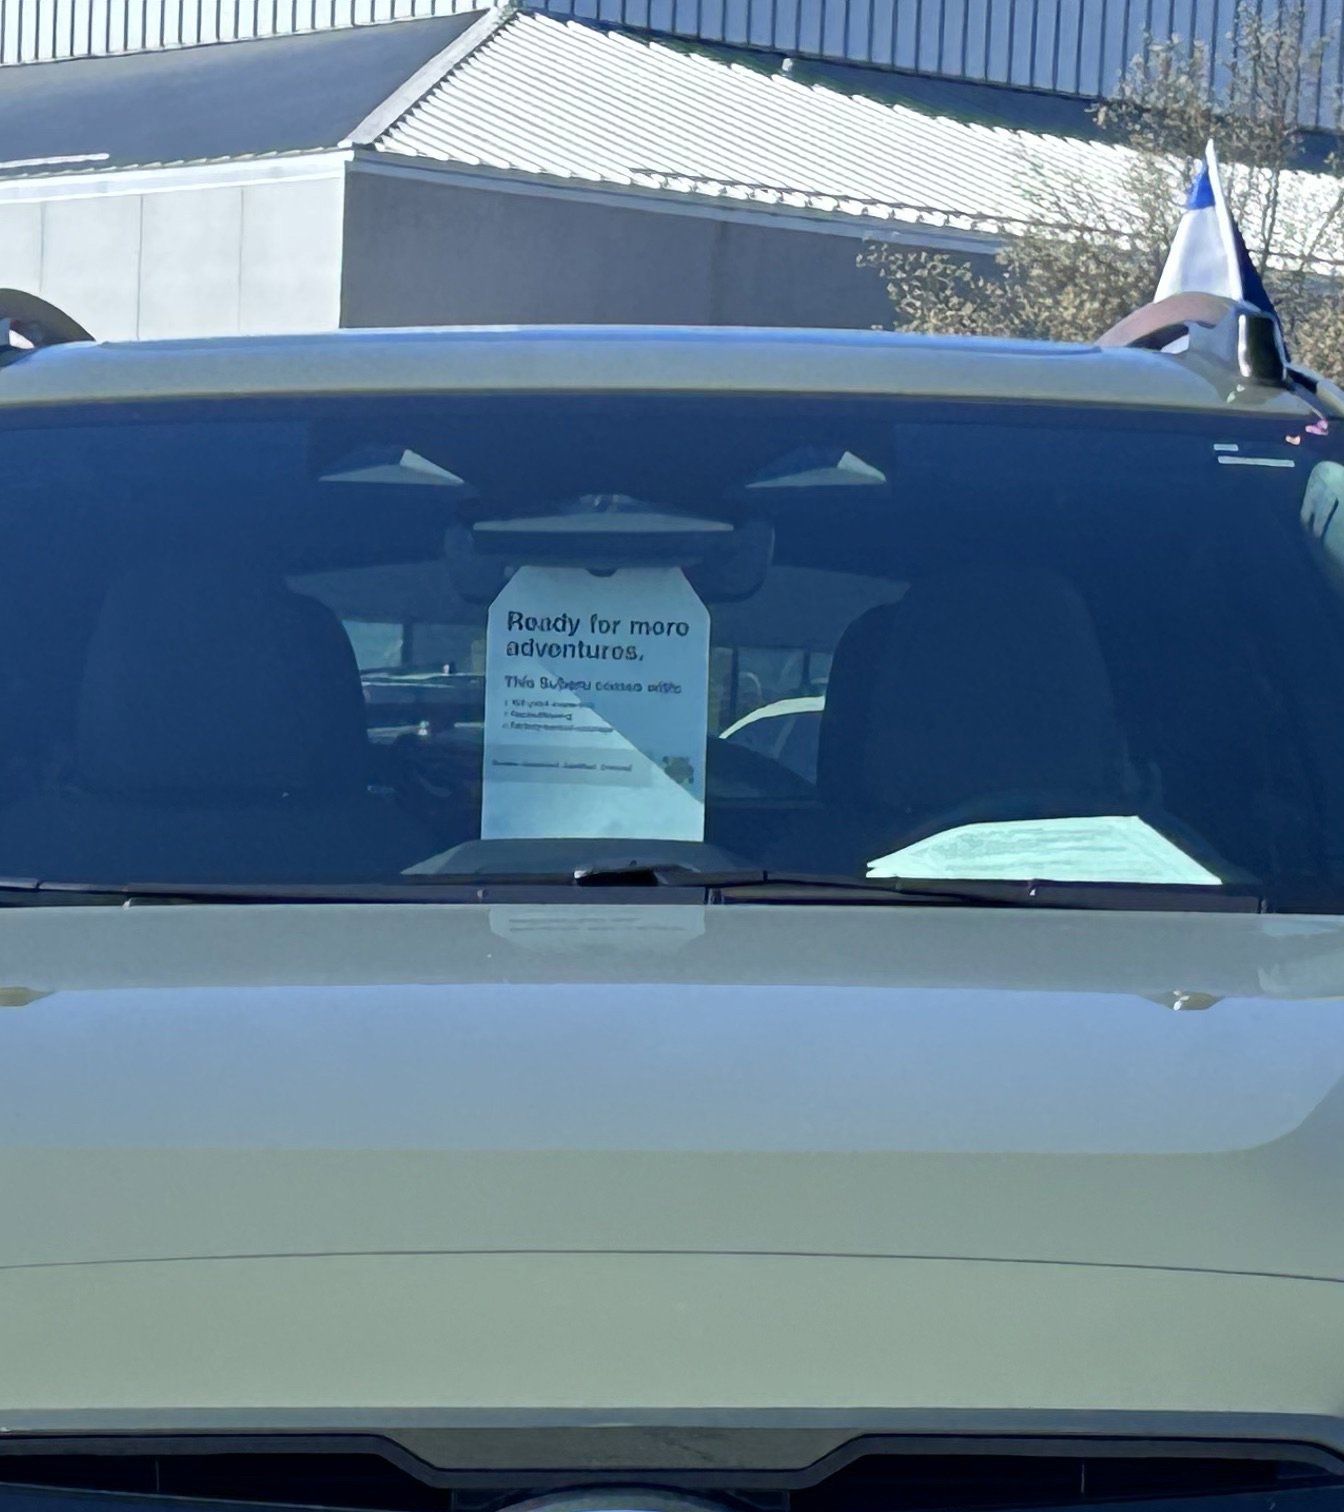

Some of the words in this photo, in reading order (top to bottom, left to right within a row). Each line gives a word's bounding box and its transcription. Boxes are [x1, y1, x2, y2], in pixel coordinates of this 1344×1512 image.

[507, 611, 581, 637] Ready
[590, 614, 622, 635] for
[630, 619, 690, 637] more
